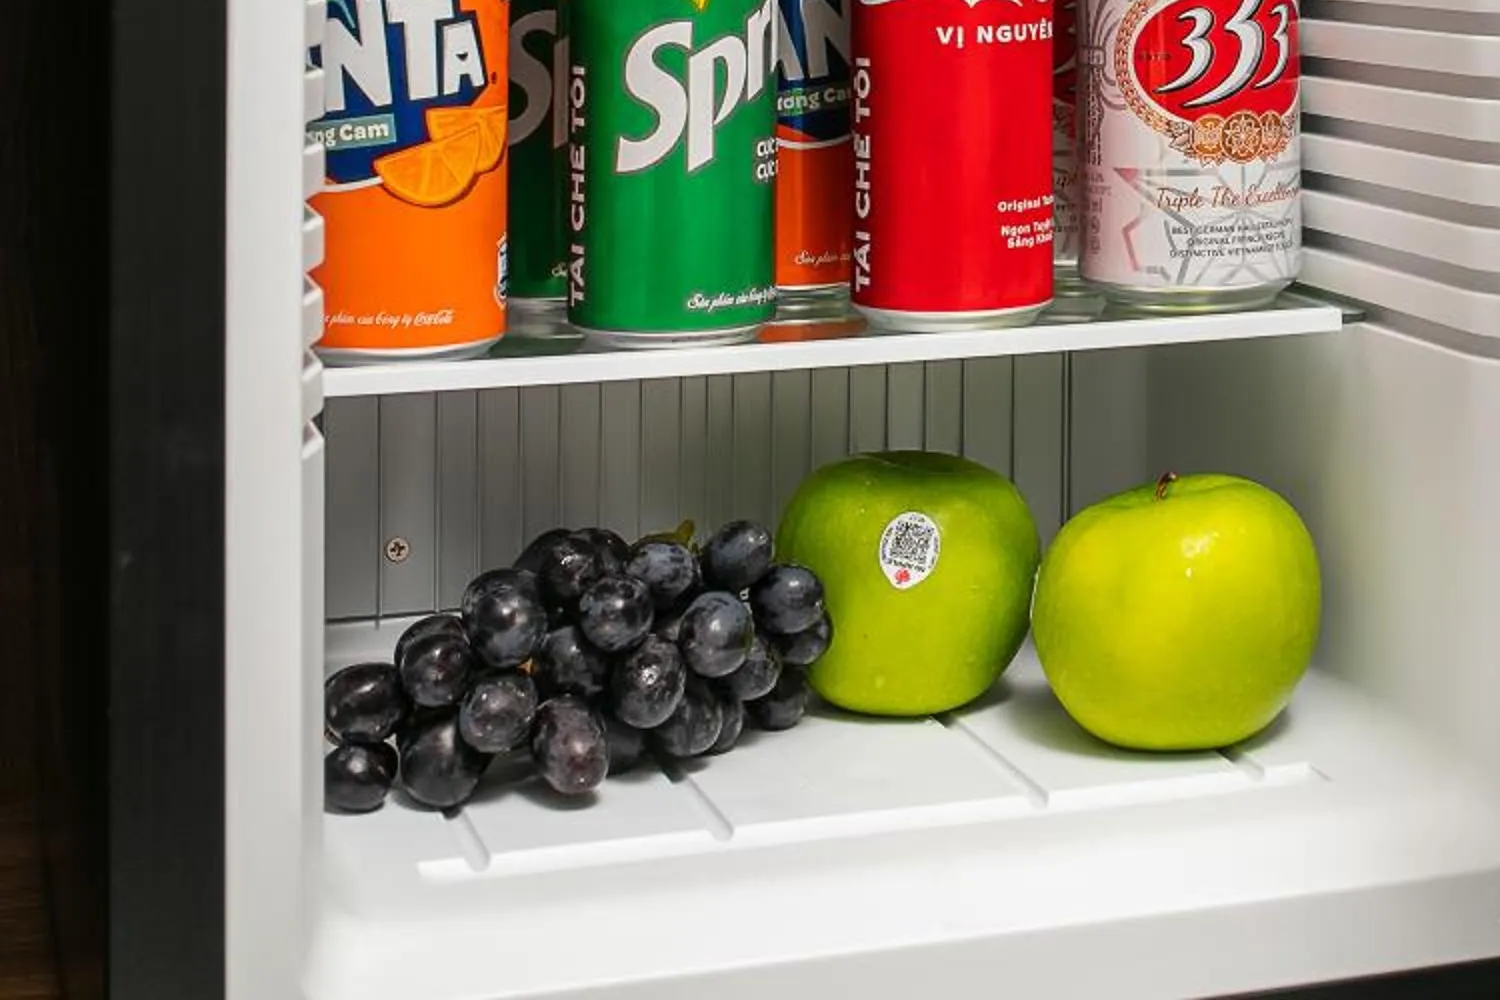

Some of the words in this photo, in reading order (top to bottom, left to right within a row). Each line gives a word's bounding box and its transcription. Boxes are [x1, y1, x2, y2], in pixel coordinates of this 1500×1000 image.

[936, 25, 964, 49] VỊ
[339, 121, 389, 141] Cam
[997, 196, 1041, 213] Original
